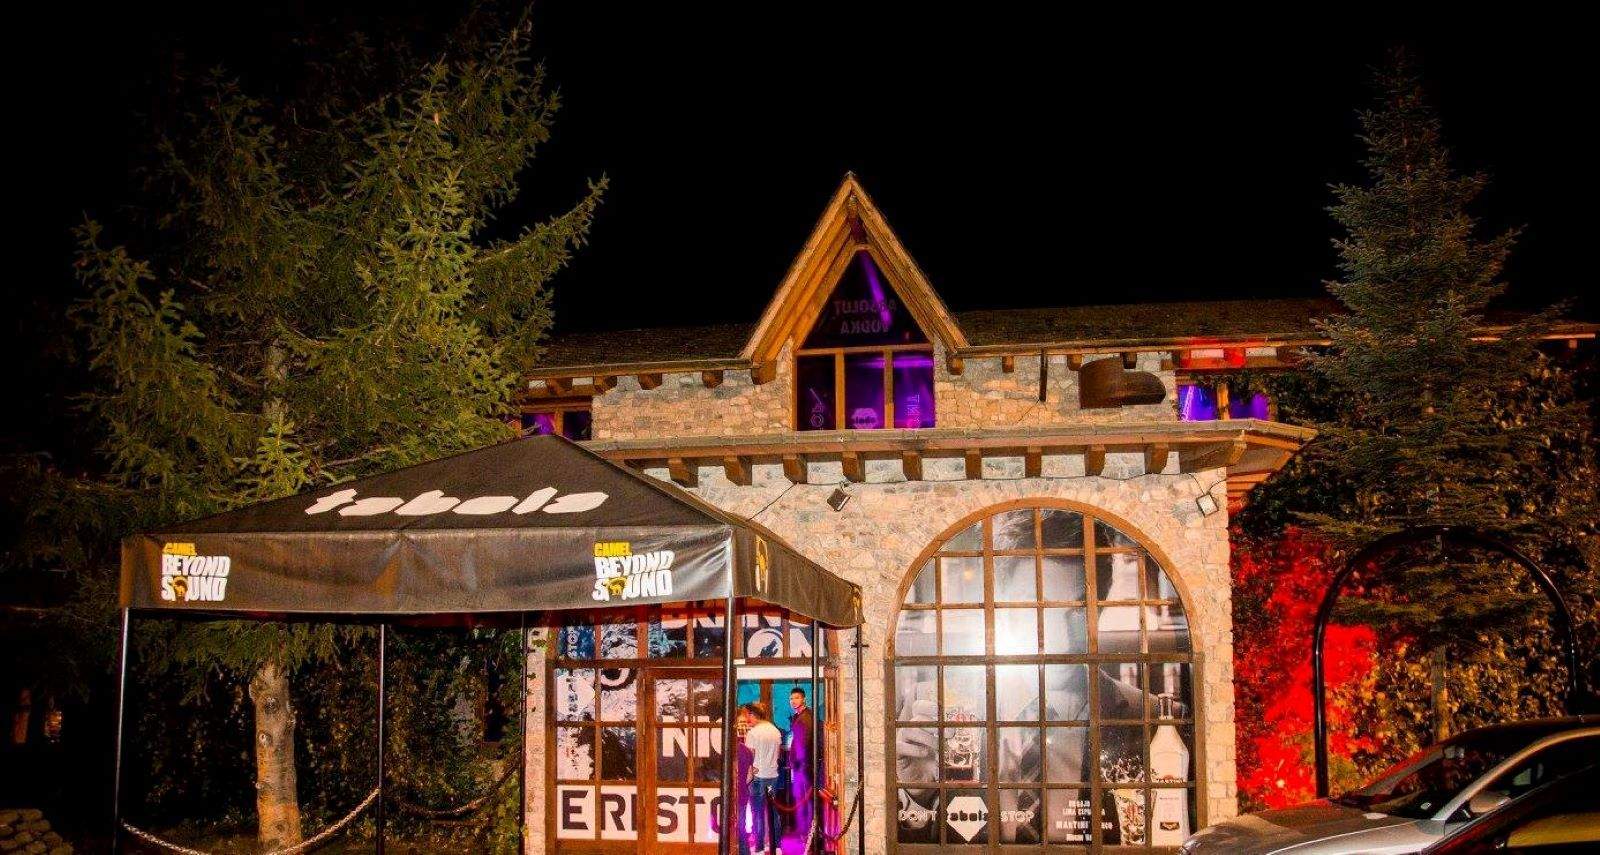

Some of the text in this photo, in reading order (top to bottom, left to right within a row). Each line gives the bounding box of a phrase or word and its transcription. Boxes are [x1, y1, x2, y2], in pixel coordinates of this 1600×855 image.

[594, 542, 631, 556] CAMEL
[162, 555, 231, 577] BEYOND
[594, 550, 675, 579] BEYOND
[1000, 810, 1034, 822] STOP
